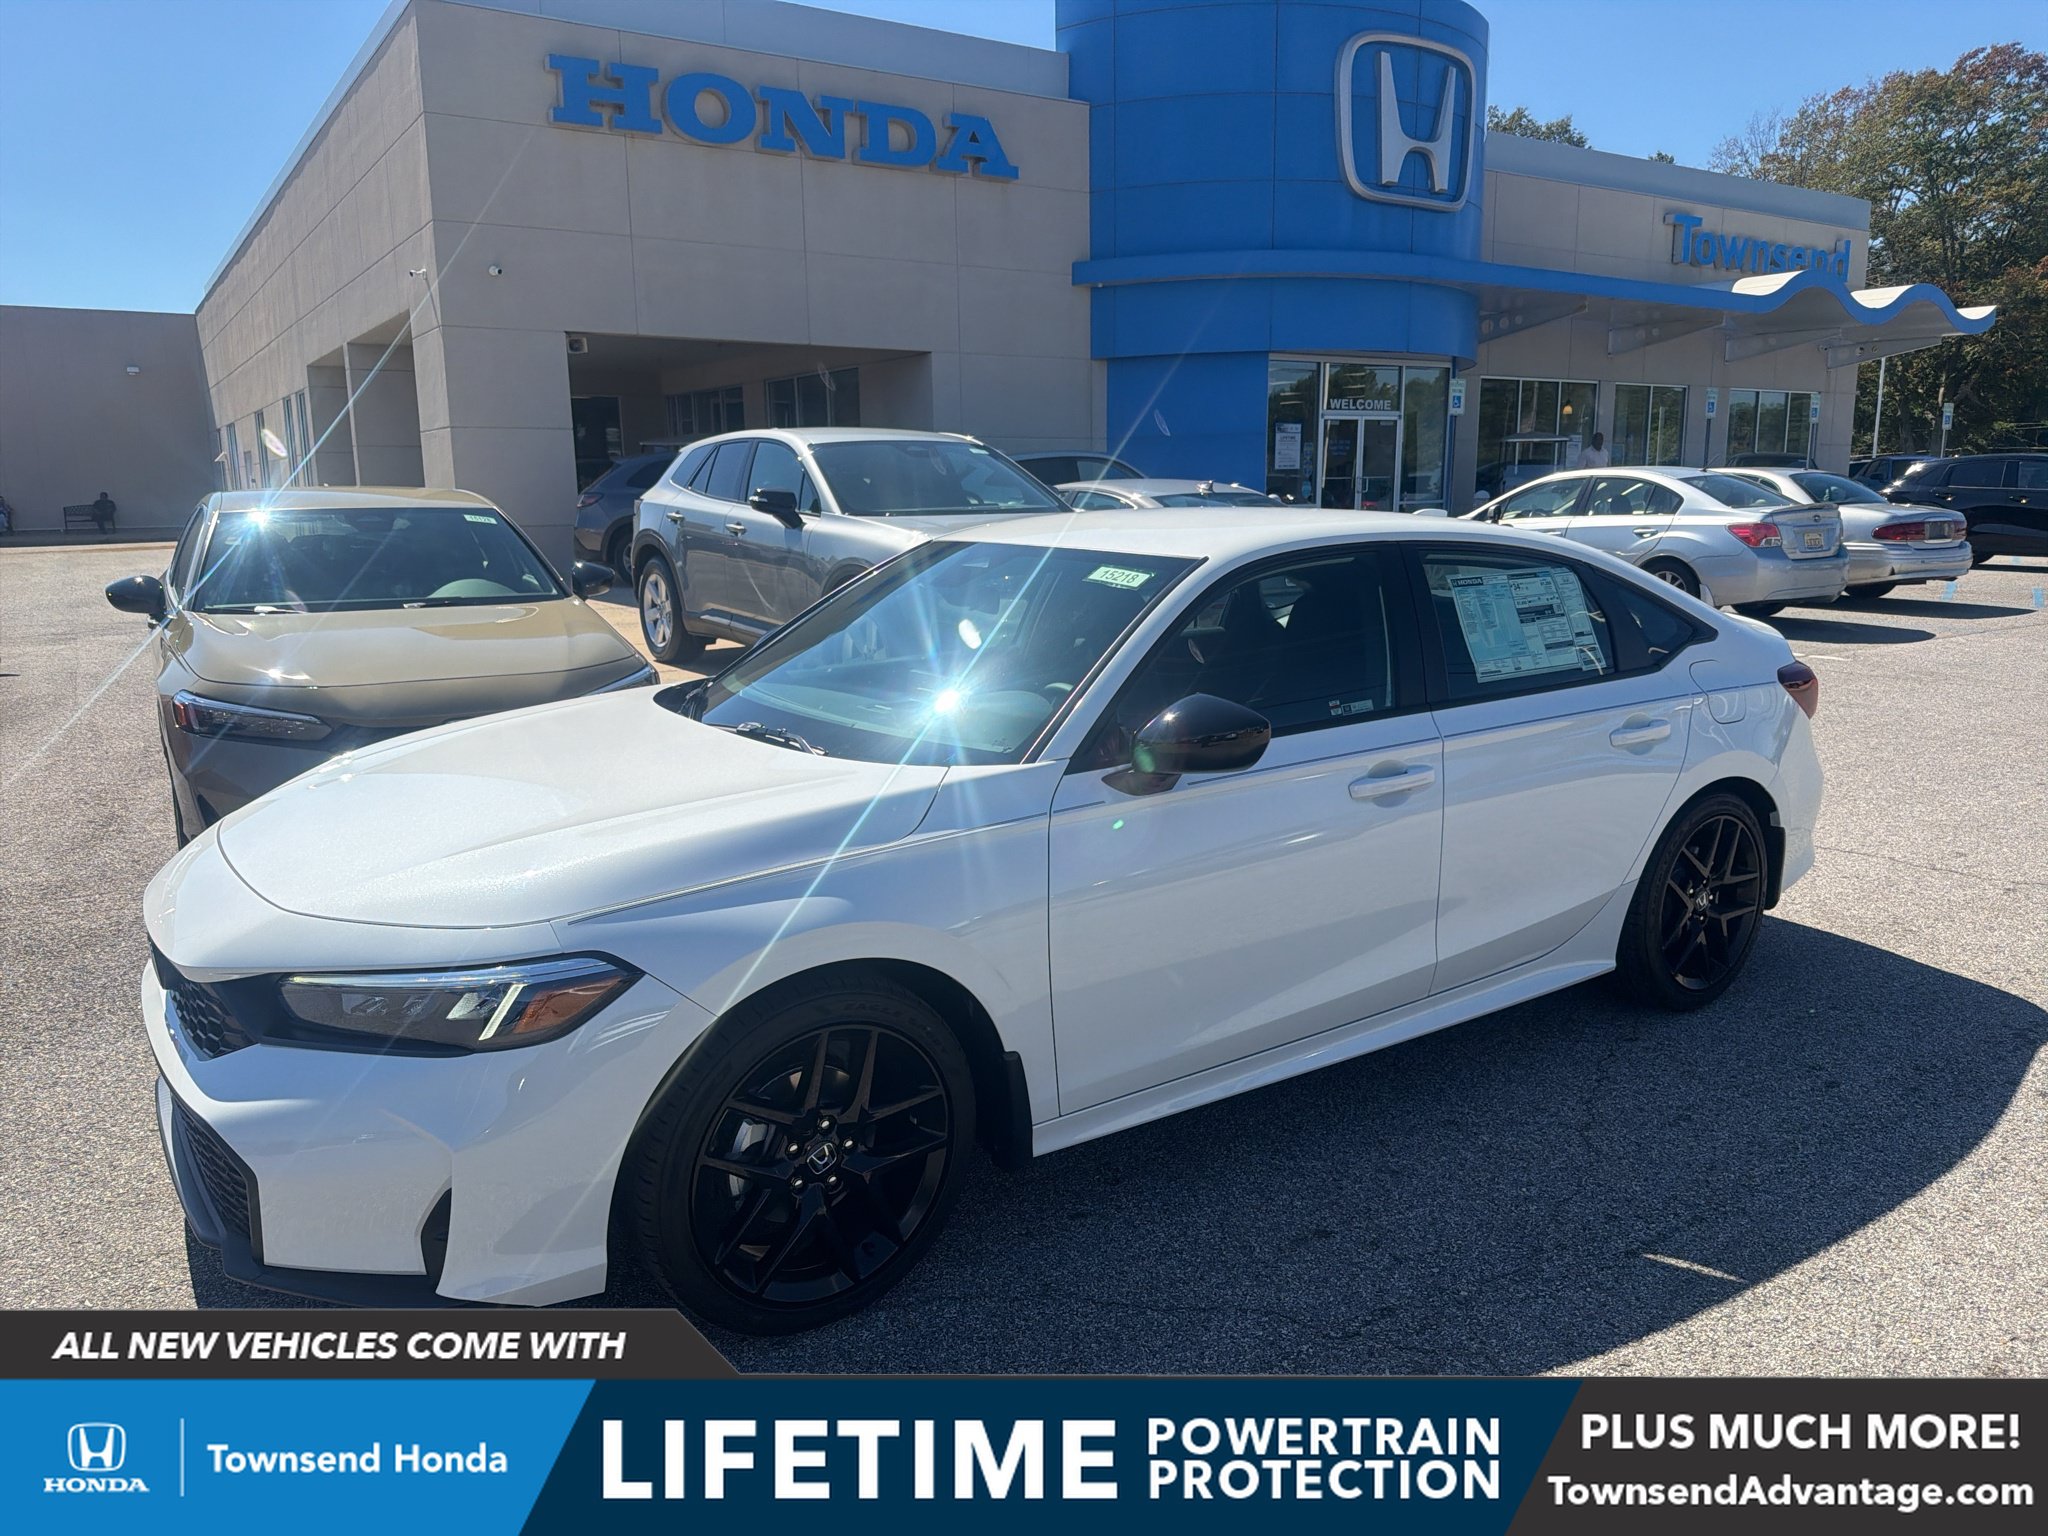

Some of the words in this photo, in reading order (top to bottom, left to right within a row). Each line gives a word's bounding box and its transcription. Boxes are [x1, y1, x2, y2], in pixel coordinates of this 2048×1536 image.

[548, 53, 1020, 180] HONDA
[1667, 213, 1852, 283] Townsend
[1329, 398, 1392, 411] WELCOME
[1099, 568, 1139, 584] 15218
